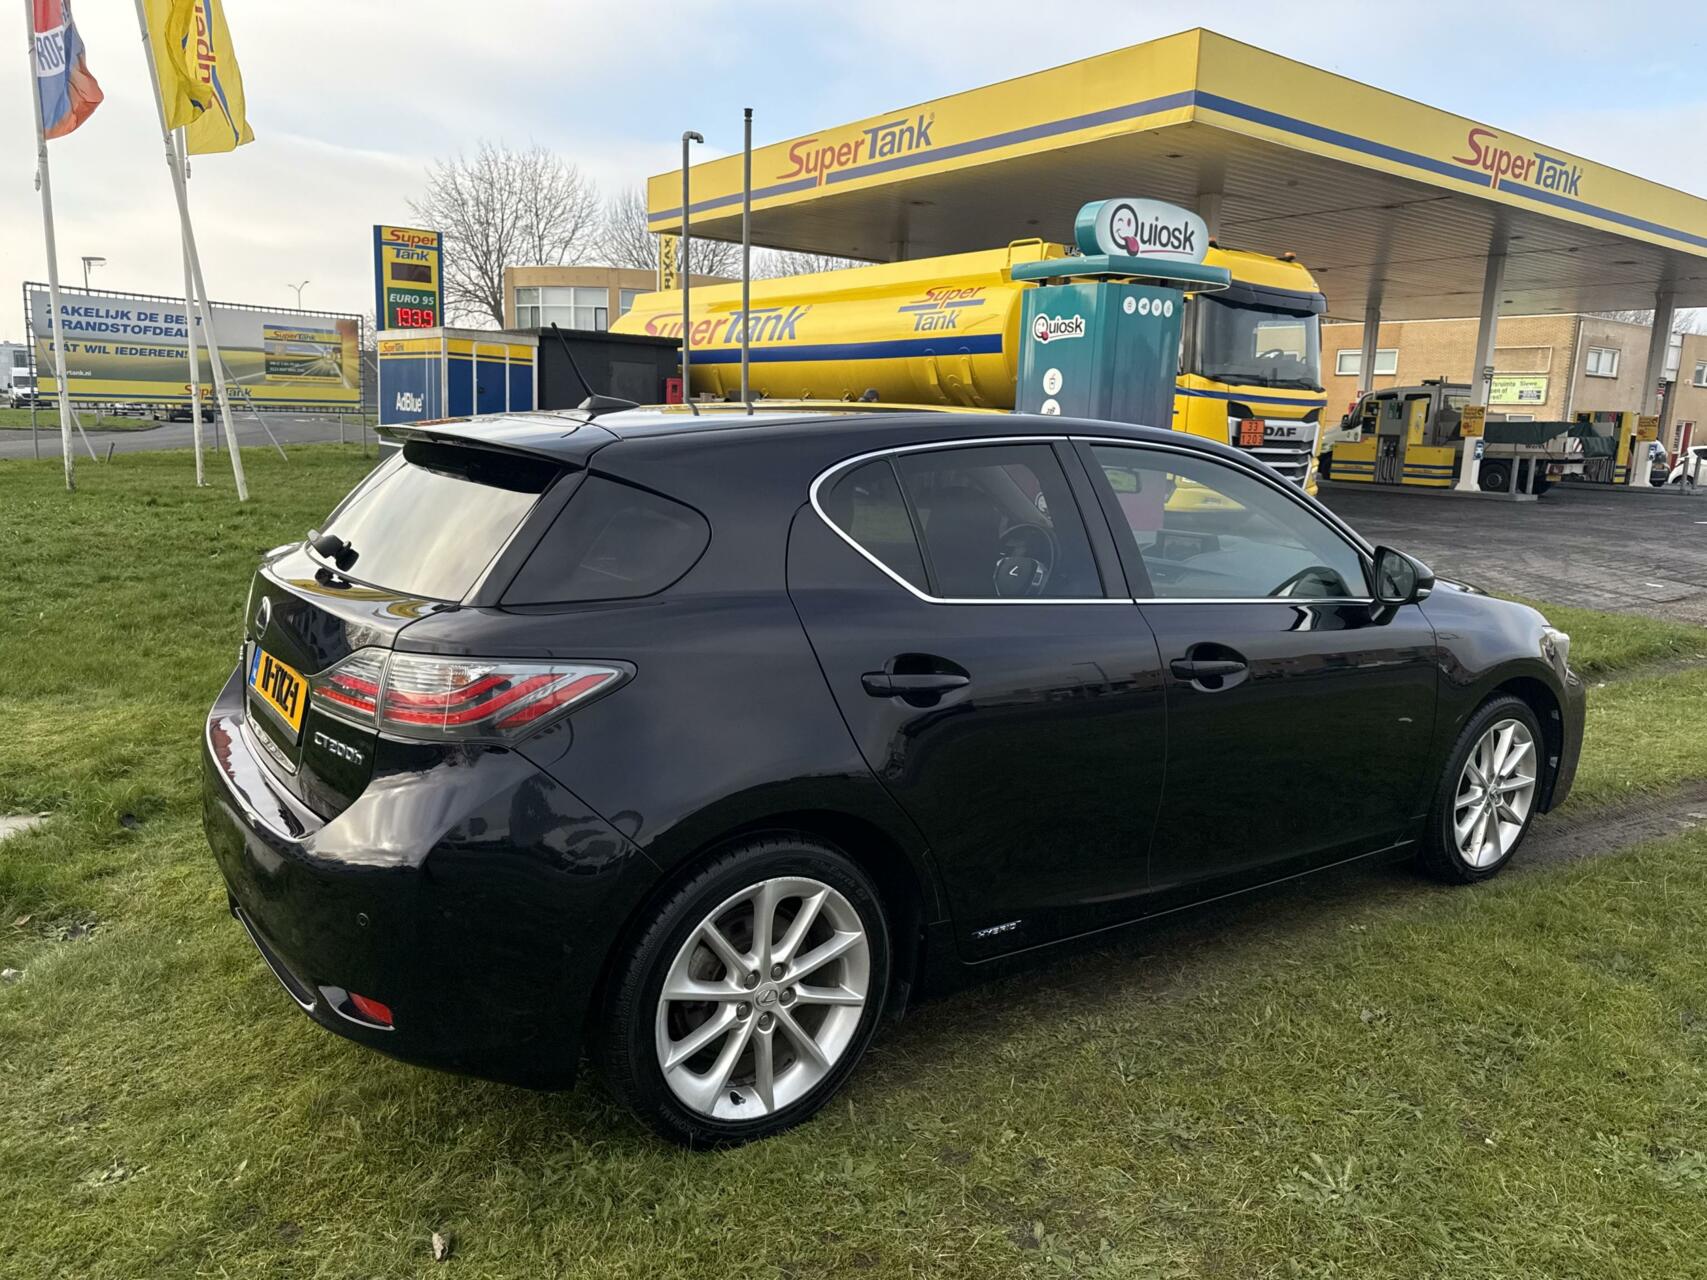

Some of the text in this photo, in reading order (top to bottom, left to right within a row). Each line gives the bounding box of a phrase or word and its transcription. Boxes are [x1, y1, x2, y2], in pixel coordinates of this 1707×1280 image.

[776, 114, 934, 186] SuperTank
[1452, 128, 1582, 197] SuperTank
[384, 229, 437, 248] Super
[1109, 203, 1195, 254] Quiosk
[391, 247, 429, 262] Tank
[389, 293, 435, 306] EURO 95
[909, 286, 986, 309] Super
[136, 311, 159, 323] DE
[914, 310, 960, 332] Tank
[1034, 315, 1083, 340] Quiosk
[84, 344, 111, 355] WIL
[115, 346, 188, 359] IEDEREEN!
[395, 391, 423, 413] AdBlue
[1247, 421, 1258, 432] 33
[1264, 426, 1297, 437] DAF
[1241, 434, 1263, 444] 1203
[314, 731, 364, 766] CT200h
